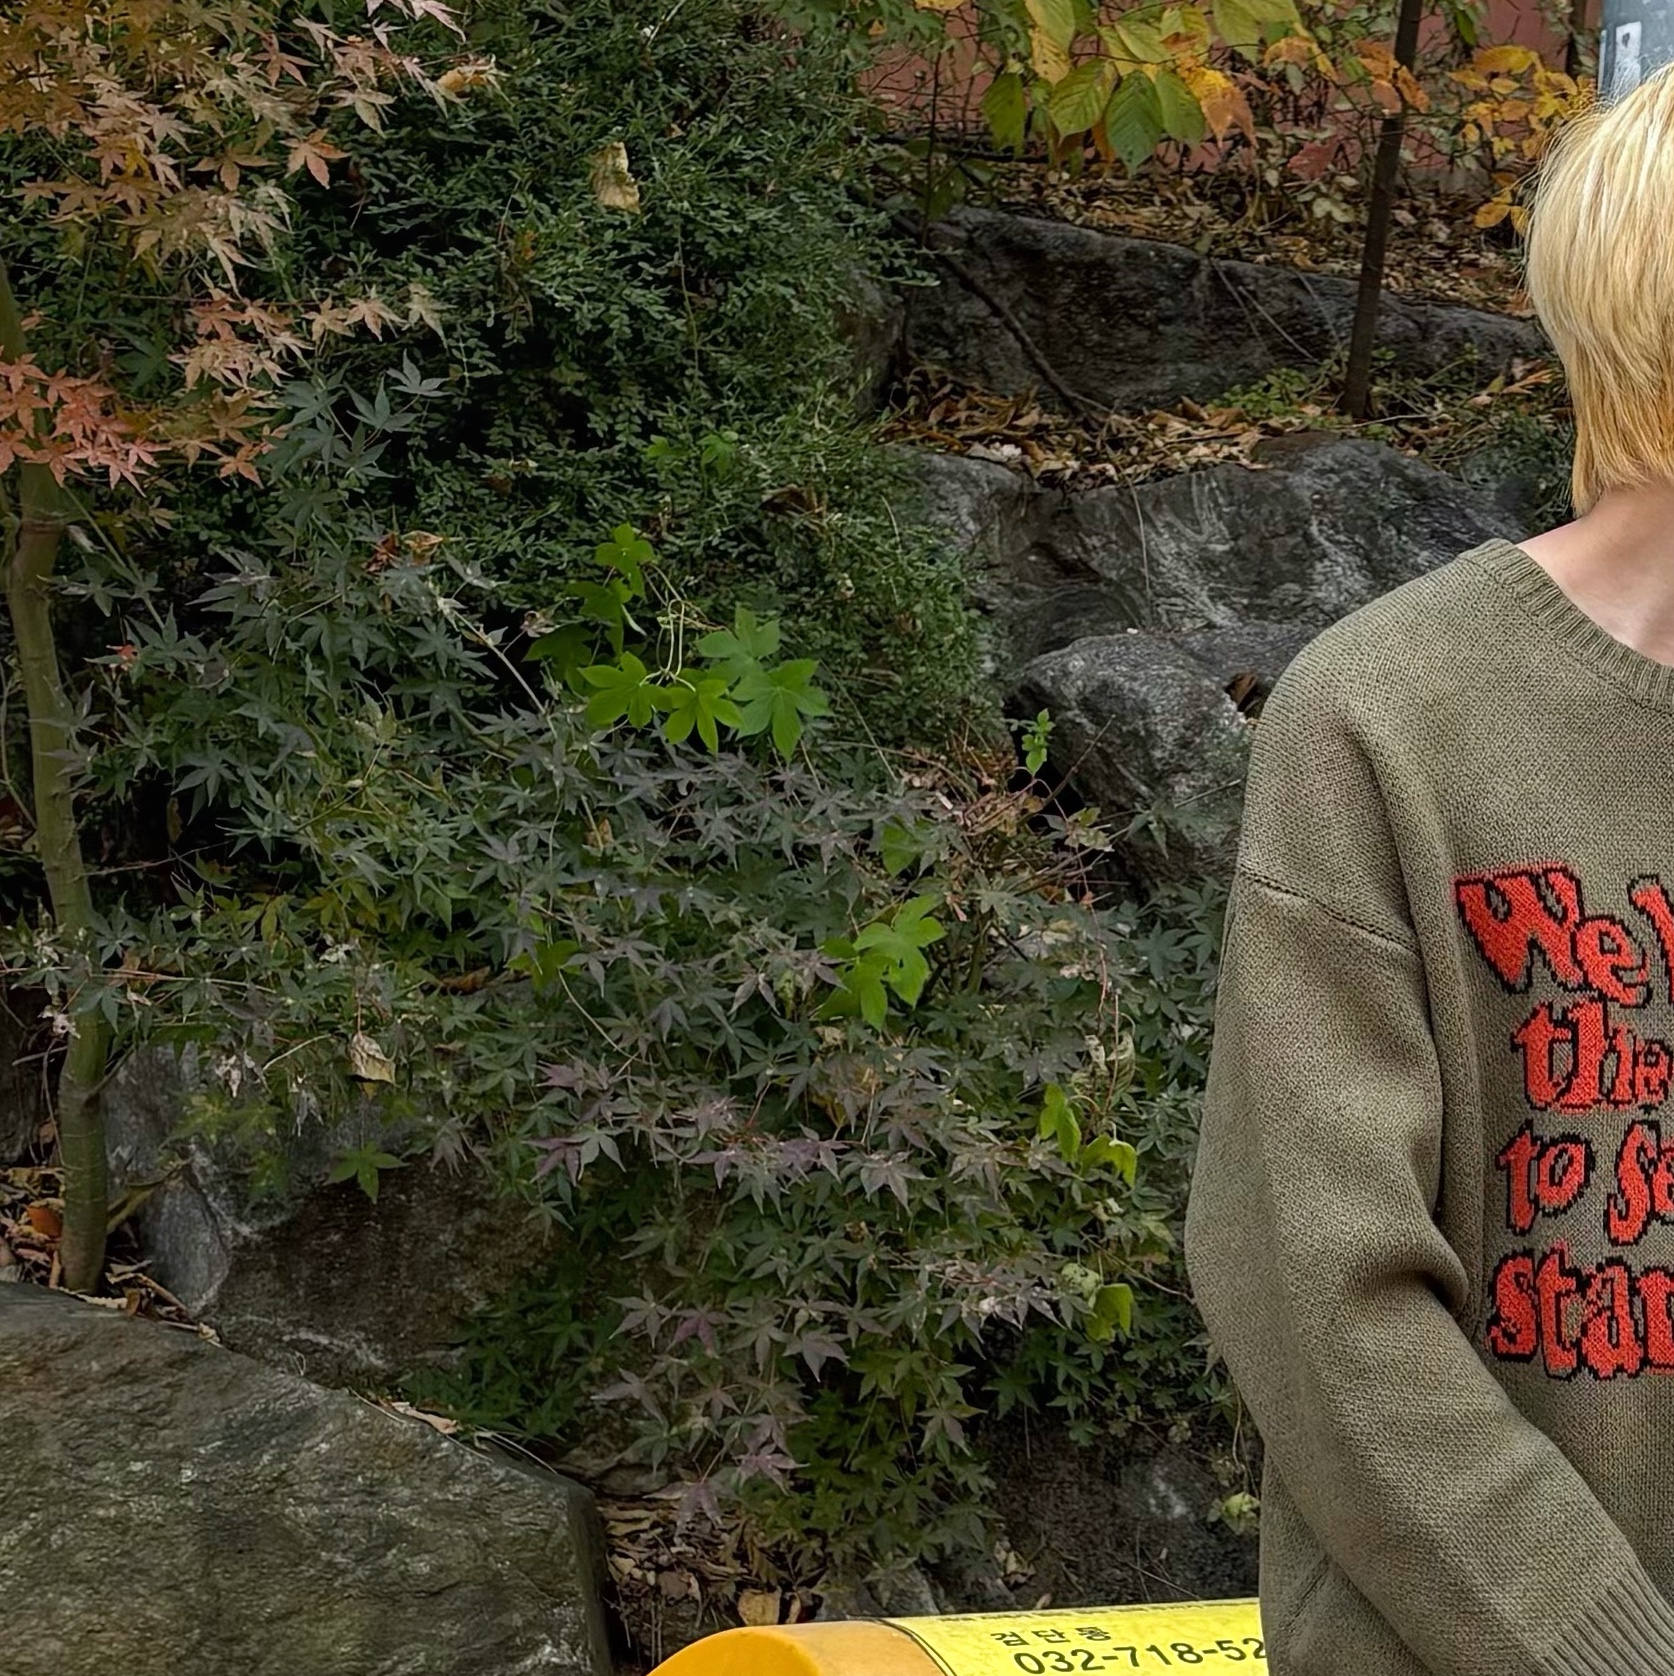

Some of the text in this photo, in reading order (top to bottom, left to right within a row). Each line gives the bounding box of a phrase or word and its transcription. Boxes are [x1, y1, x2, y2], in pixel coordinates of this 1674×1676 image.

[1456, 862, 1652, 1008] We
[1512, 1000, 1674, 1114] the
[1497, 1119, 1595, 1236] to
[1014, 1637, 1266, 1675] 032-718-52
